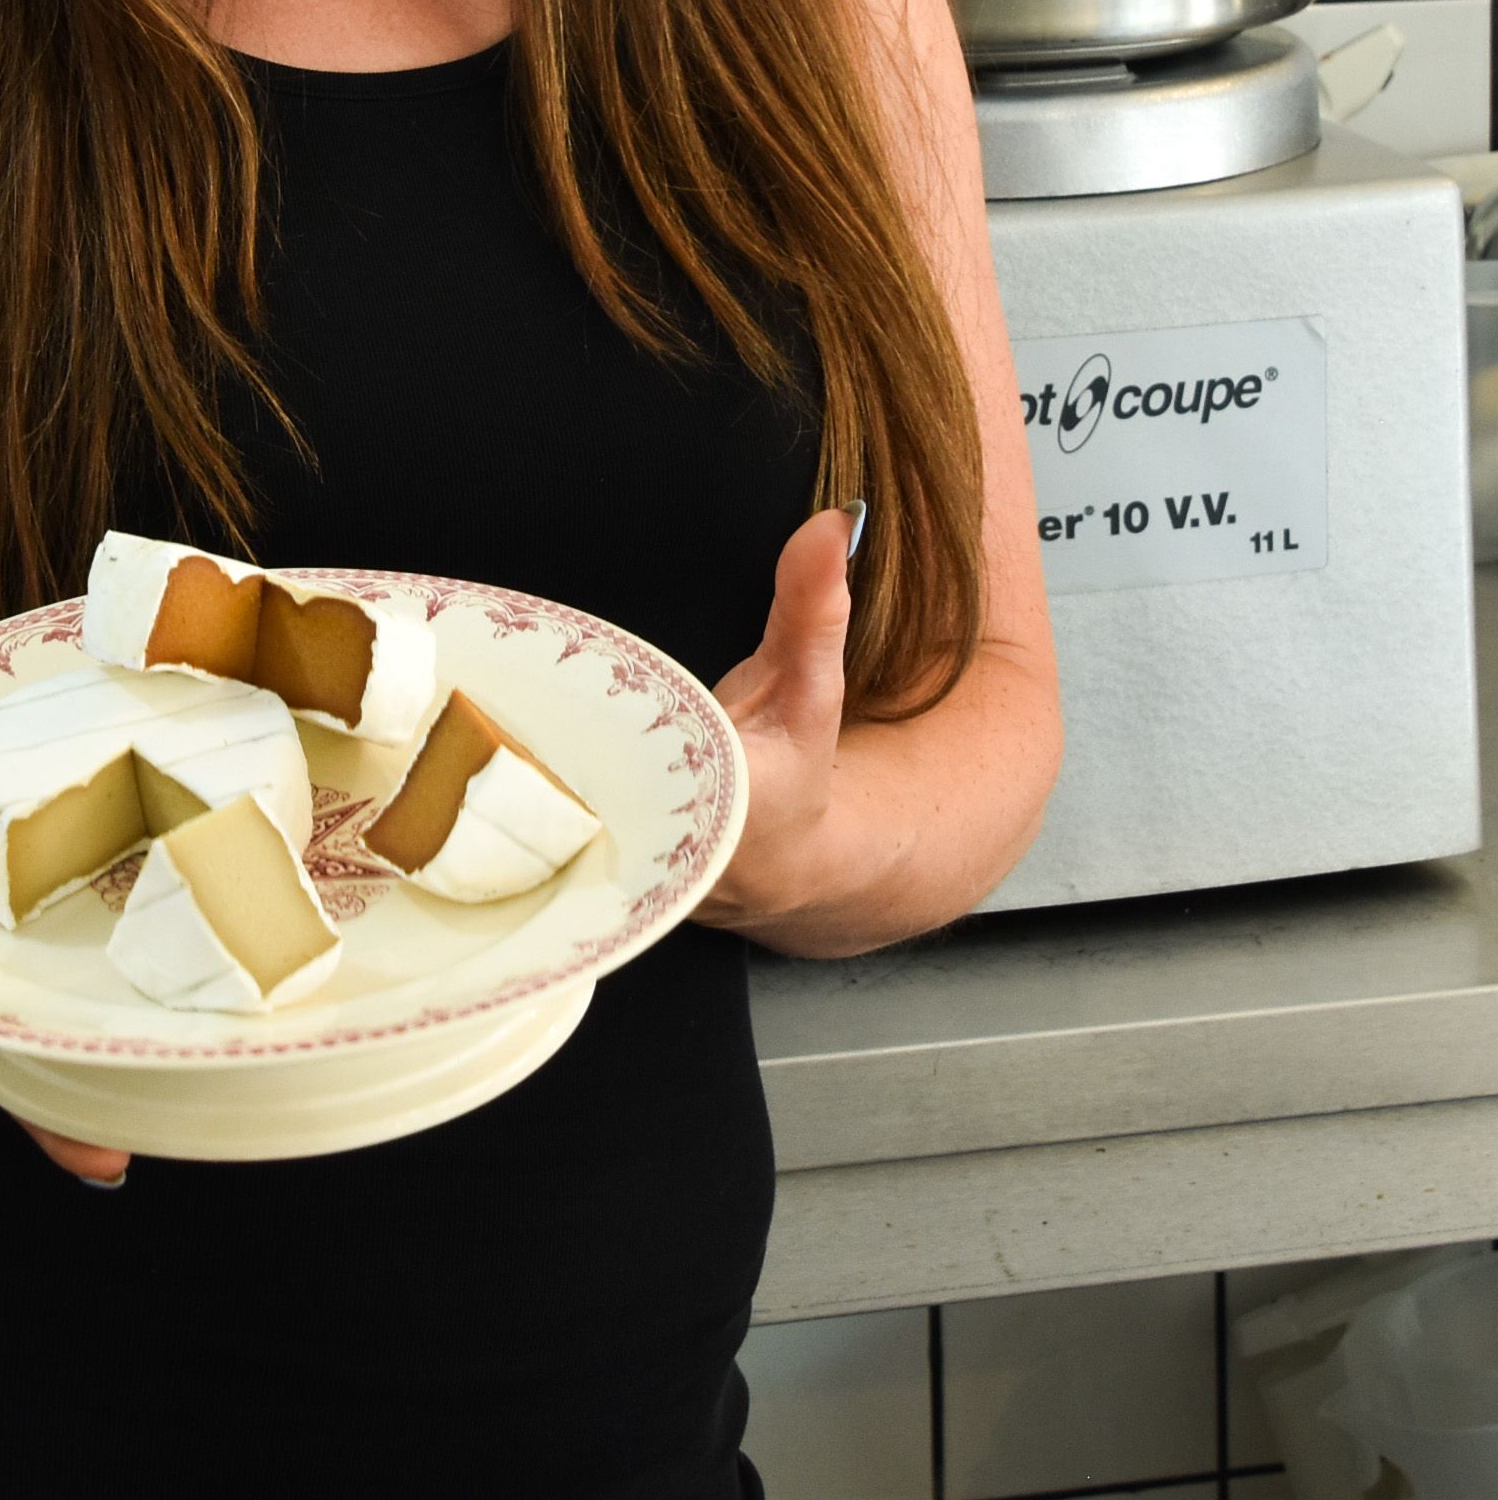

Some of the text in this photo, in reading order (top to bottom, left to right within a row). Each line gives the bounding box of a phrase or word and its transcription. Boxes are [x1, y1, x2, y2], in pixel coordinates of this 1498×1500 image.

[1102, 500, 1150, 536] 10
[1164, 491, 1237, 530] V.V.
[1250, 528, 1299, 553] 11 L
